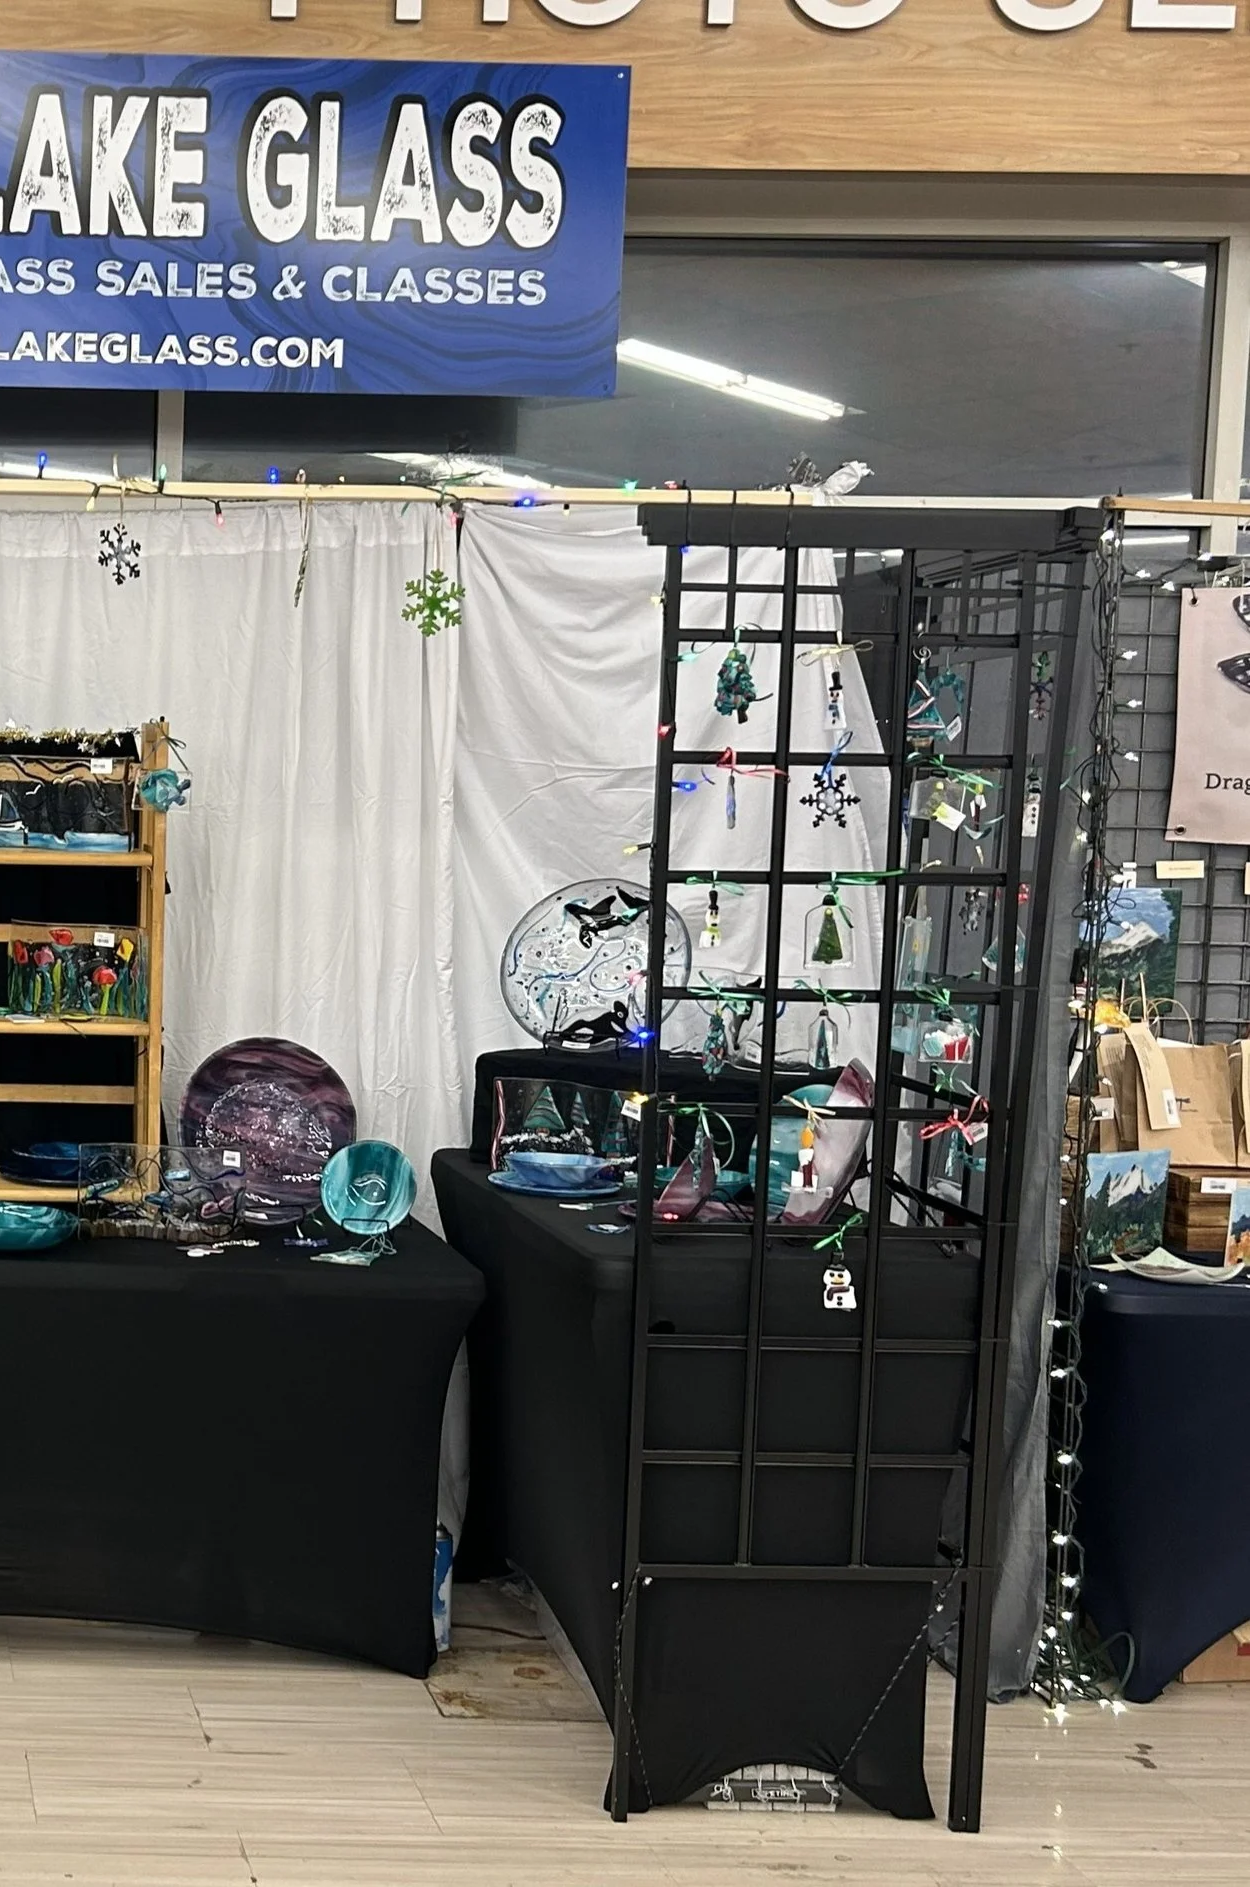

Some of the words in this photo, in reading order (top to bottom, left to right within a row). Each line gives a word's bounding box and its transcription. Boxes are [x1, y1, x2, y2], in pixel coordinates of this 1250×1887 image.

[246, 96, 563, 249] GLASS
[96, 260, 257, 300] SALES
[272, 264, 307, 301] &
[322, 265, 547, 306] CLASSES
